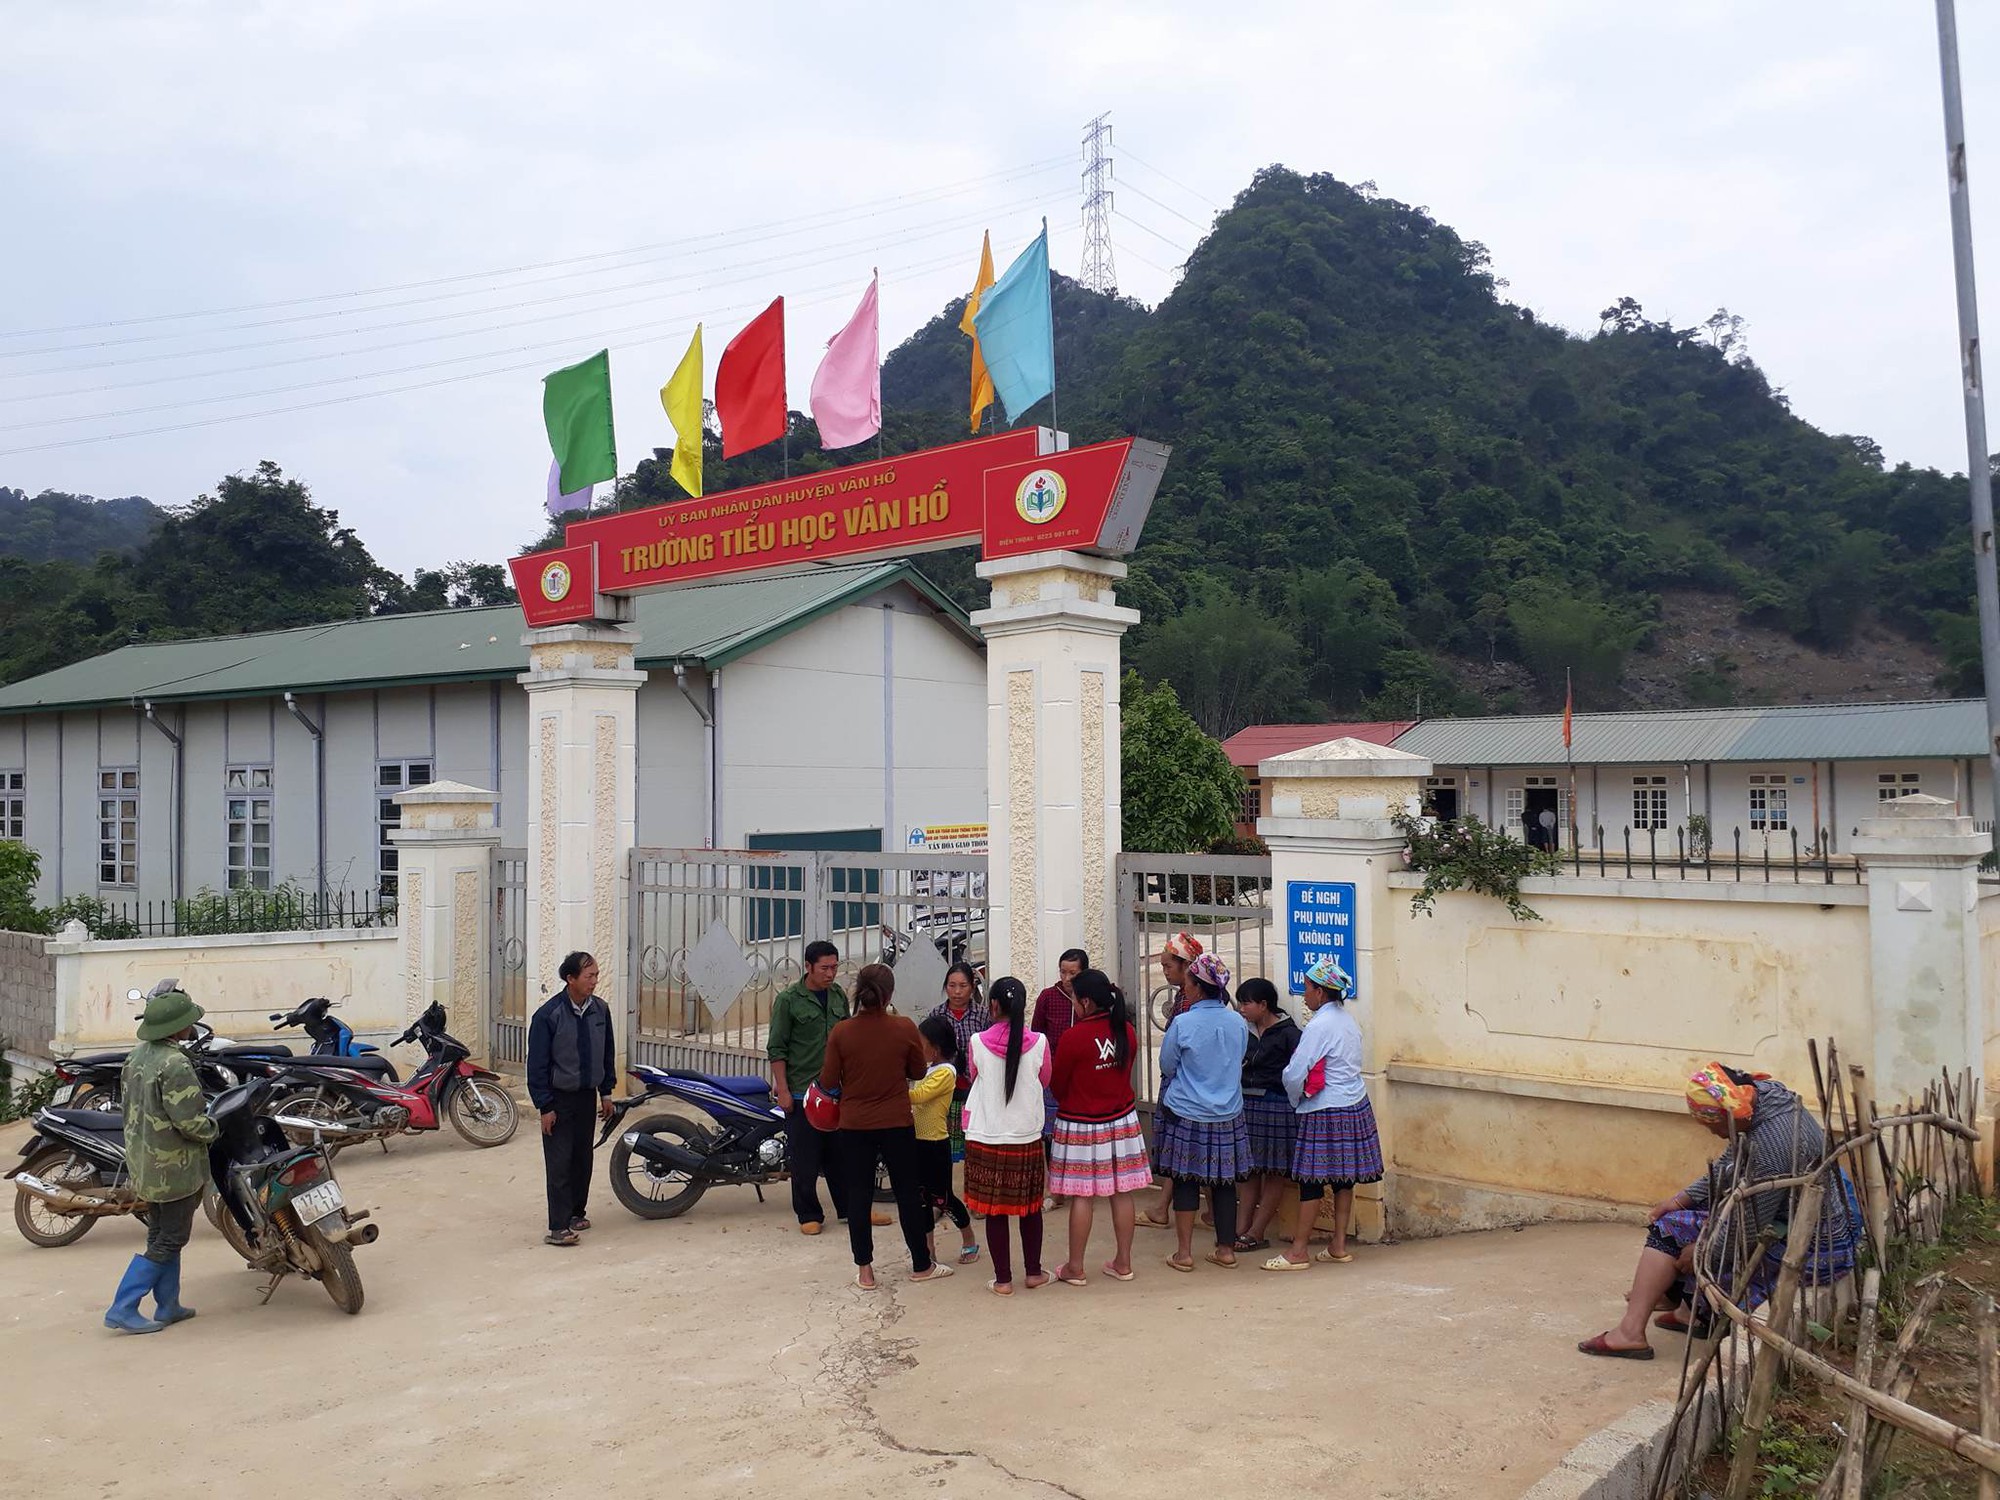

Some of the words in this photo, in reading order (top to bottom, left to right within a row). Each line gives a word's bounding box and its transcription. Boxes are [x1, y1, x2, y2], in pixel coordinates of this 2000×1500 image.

[680, 509, 708, 524] BAN
[711, 500, 750, 518] NHÂN
[752, 493, 782, 510] DÂN
[785, 483, 835, 504] HUYỆN
[839, 475, 870, 493] VÂN
[620, 532, 714, 573] TRƯỜNG
[720, 511, 776, 557] TIỂU
[781, 511, 837, 551] HỌC
[843, 497, 901, 537] VÂN
[908, 478, 949, 526] HỒ
[1301, 887, 1314, 904] ĐỀ
[1316, 891, 1341, 908] NGHỊ
[1294, 910, 1313, 927] PHỤ
[1315, 912, 1349, 926] HUYNH
[1298, 929, 1332, 947] KHÔNG
[1333, 933, 1344, 947] ĐI
[1303, 951, 1316, 965] XE
